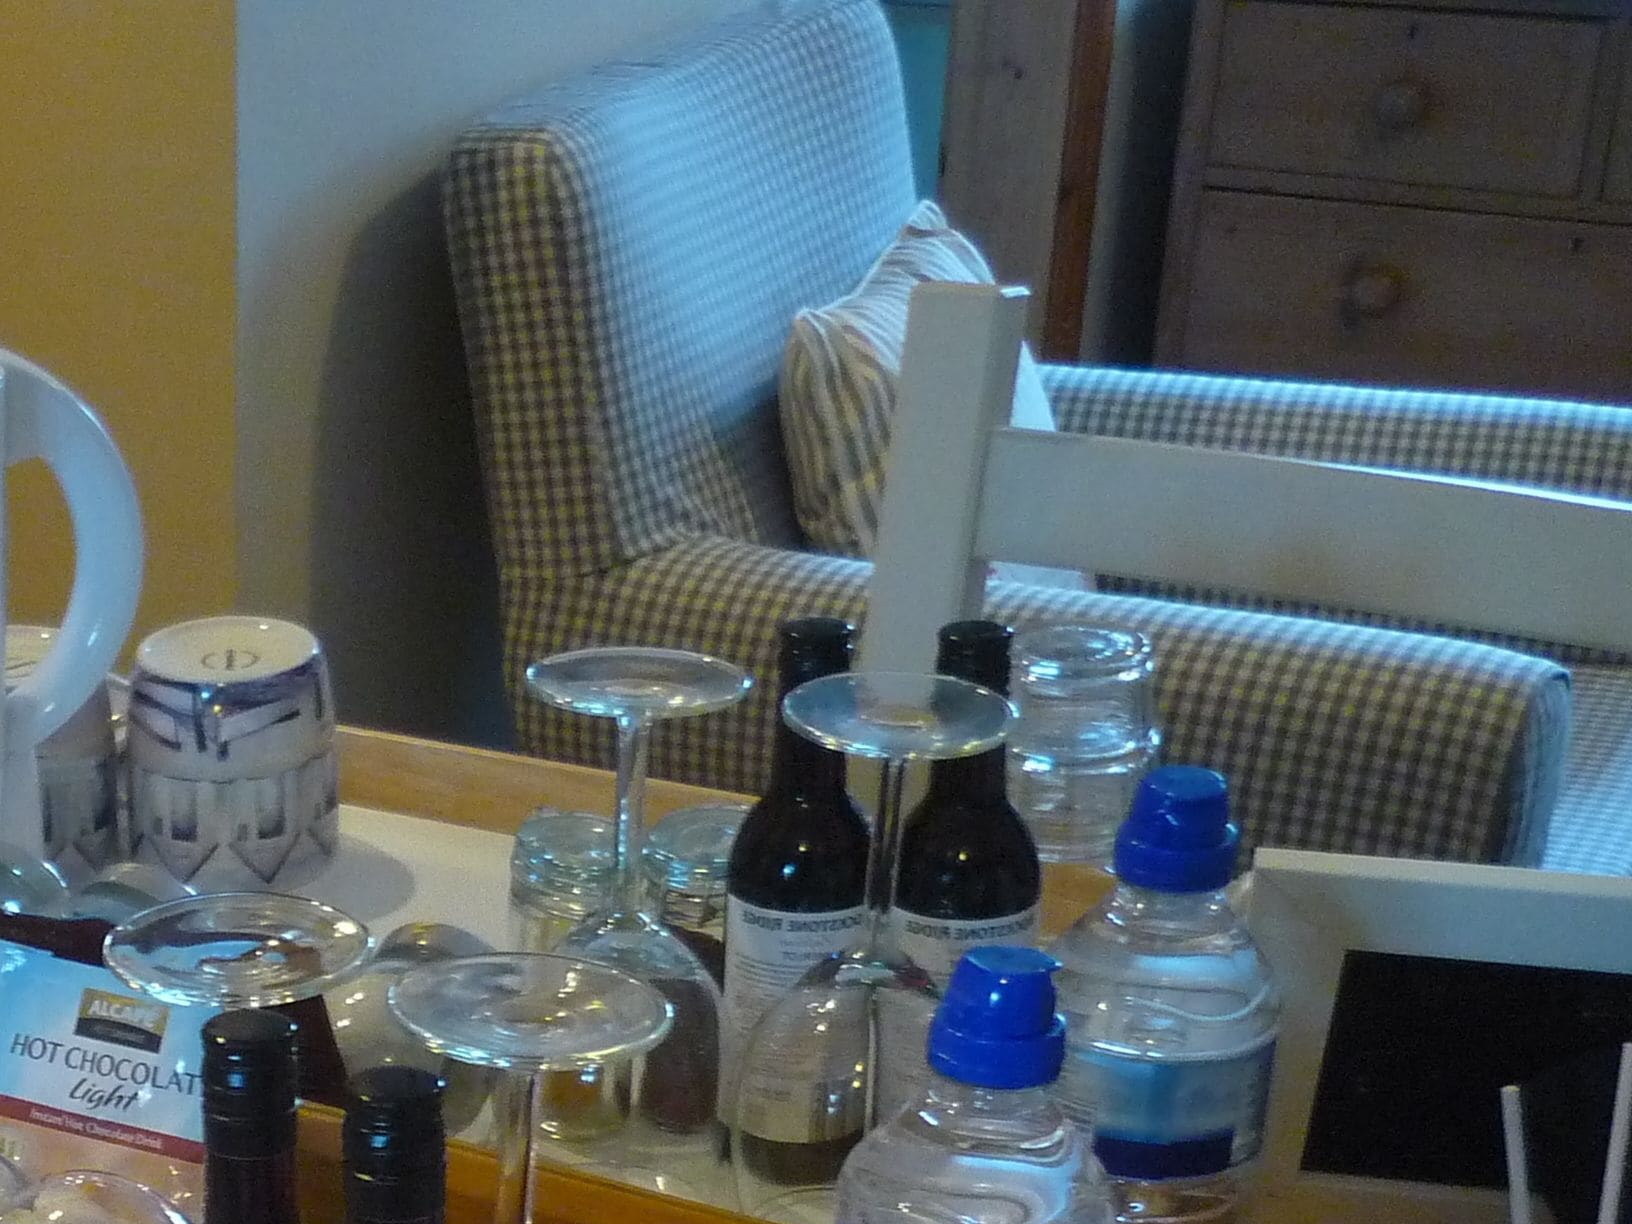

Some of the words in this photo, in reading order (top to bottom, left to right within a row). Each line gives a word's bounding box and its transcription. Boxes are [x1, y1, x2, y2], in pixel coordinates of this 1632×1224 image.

[10, 1033, 65, 1065] HOT
[64, 1046, 203, 1096] CHOCOLAT
[68, 1078, 141, 1111] Light
